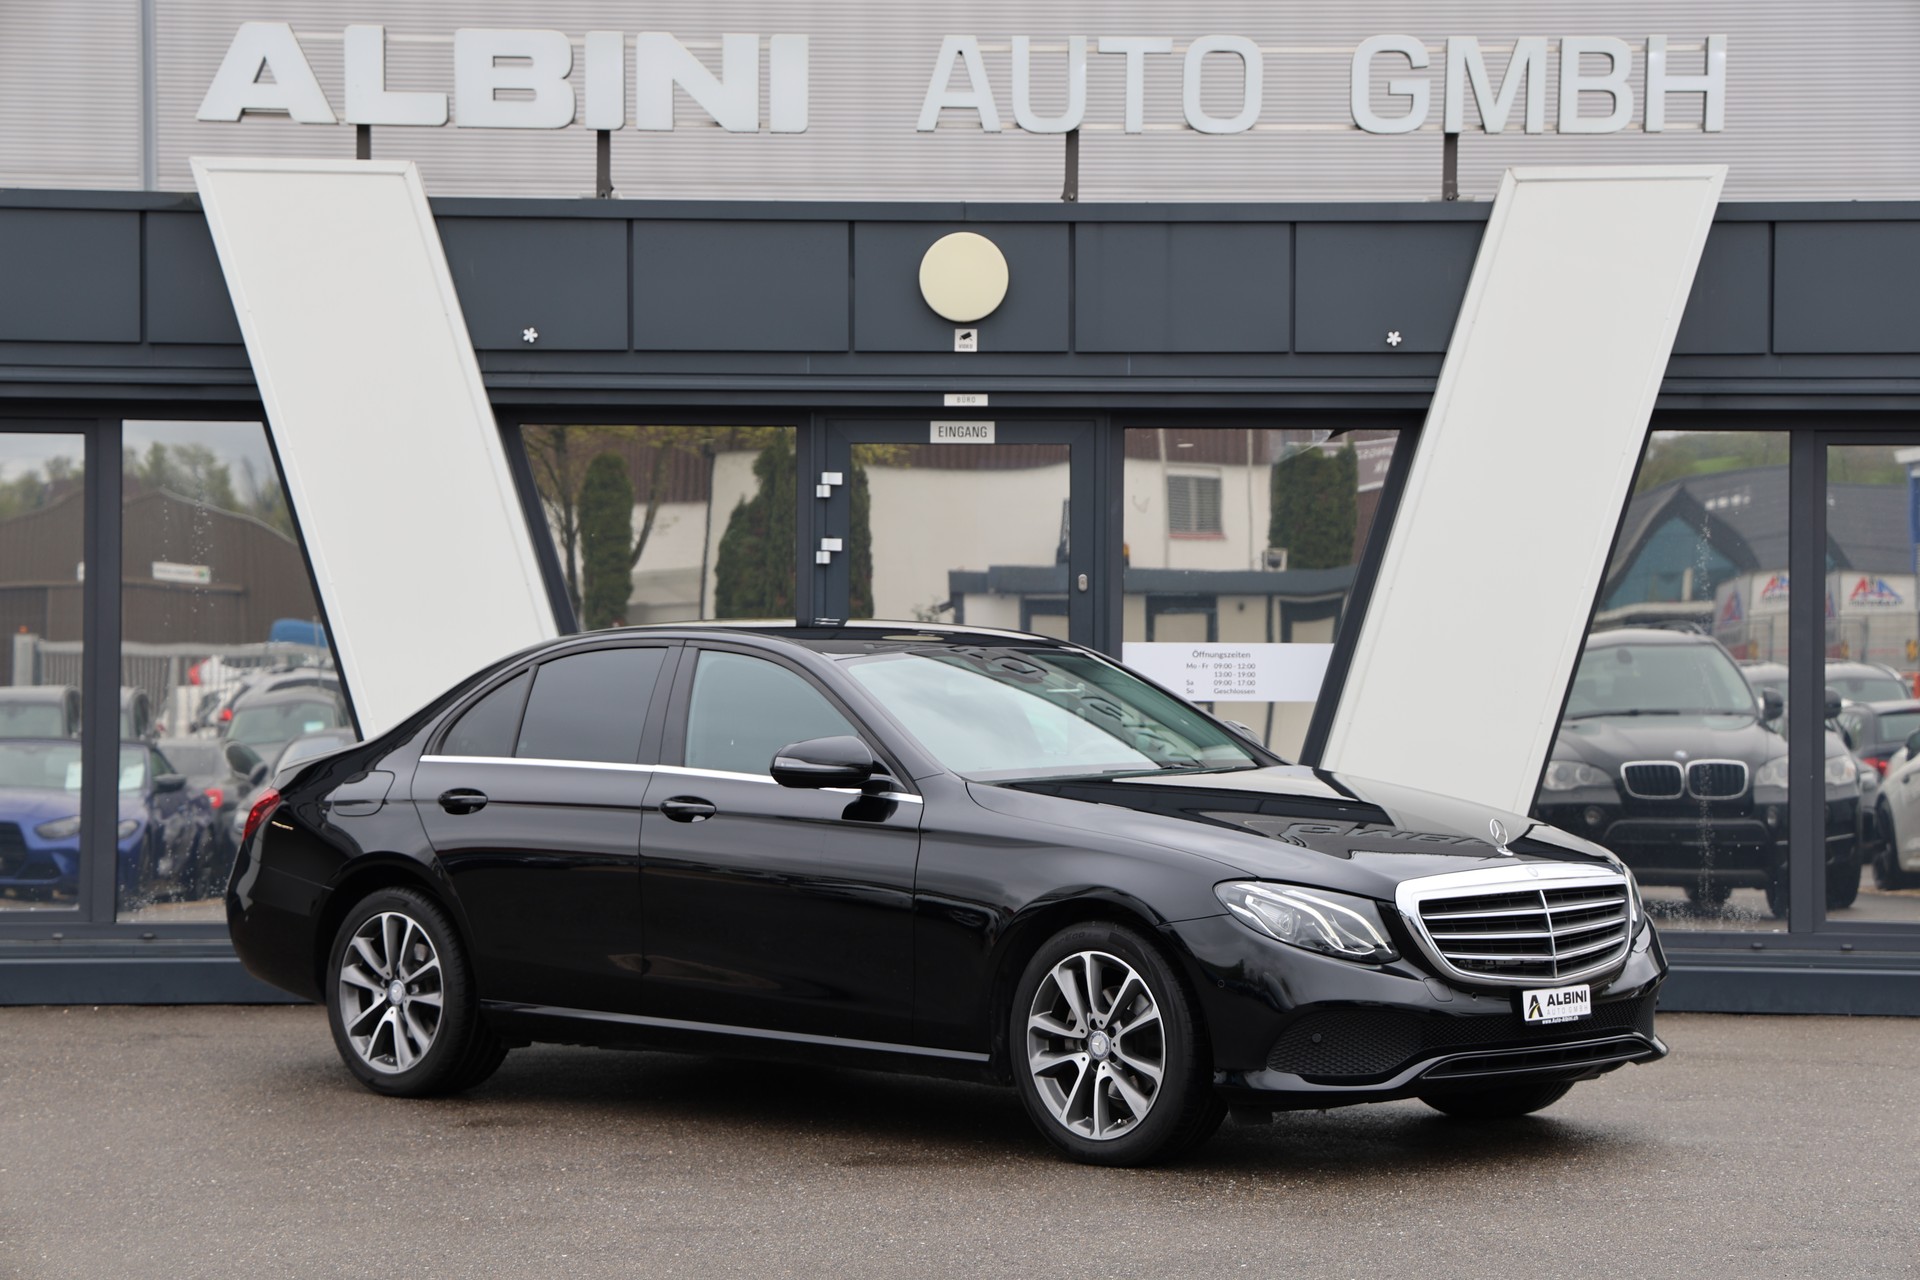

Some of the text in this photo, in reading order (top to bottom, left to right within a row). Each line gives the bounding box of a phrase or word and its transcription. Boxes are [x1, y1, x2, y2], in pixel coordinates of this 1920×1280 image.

[196, 22, 1727, 134] ALBINI AUTO GMBH
[938, 426, 987, 438] EINGANG
[1192, 650, 1251, 659] Öffnungszeiten
[1547, 990, 1587, 1007] ALBINI
[1547, 1004, 1588, 1015] AUTO GMBH
